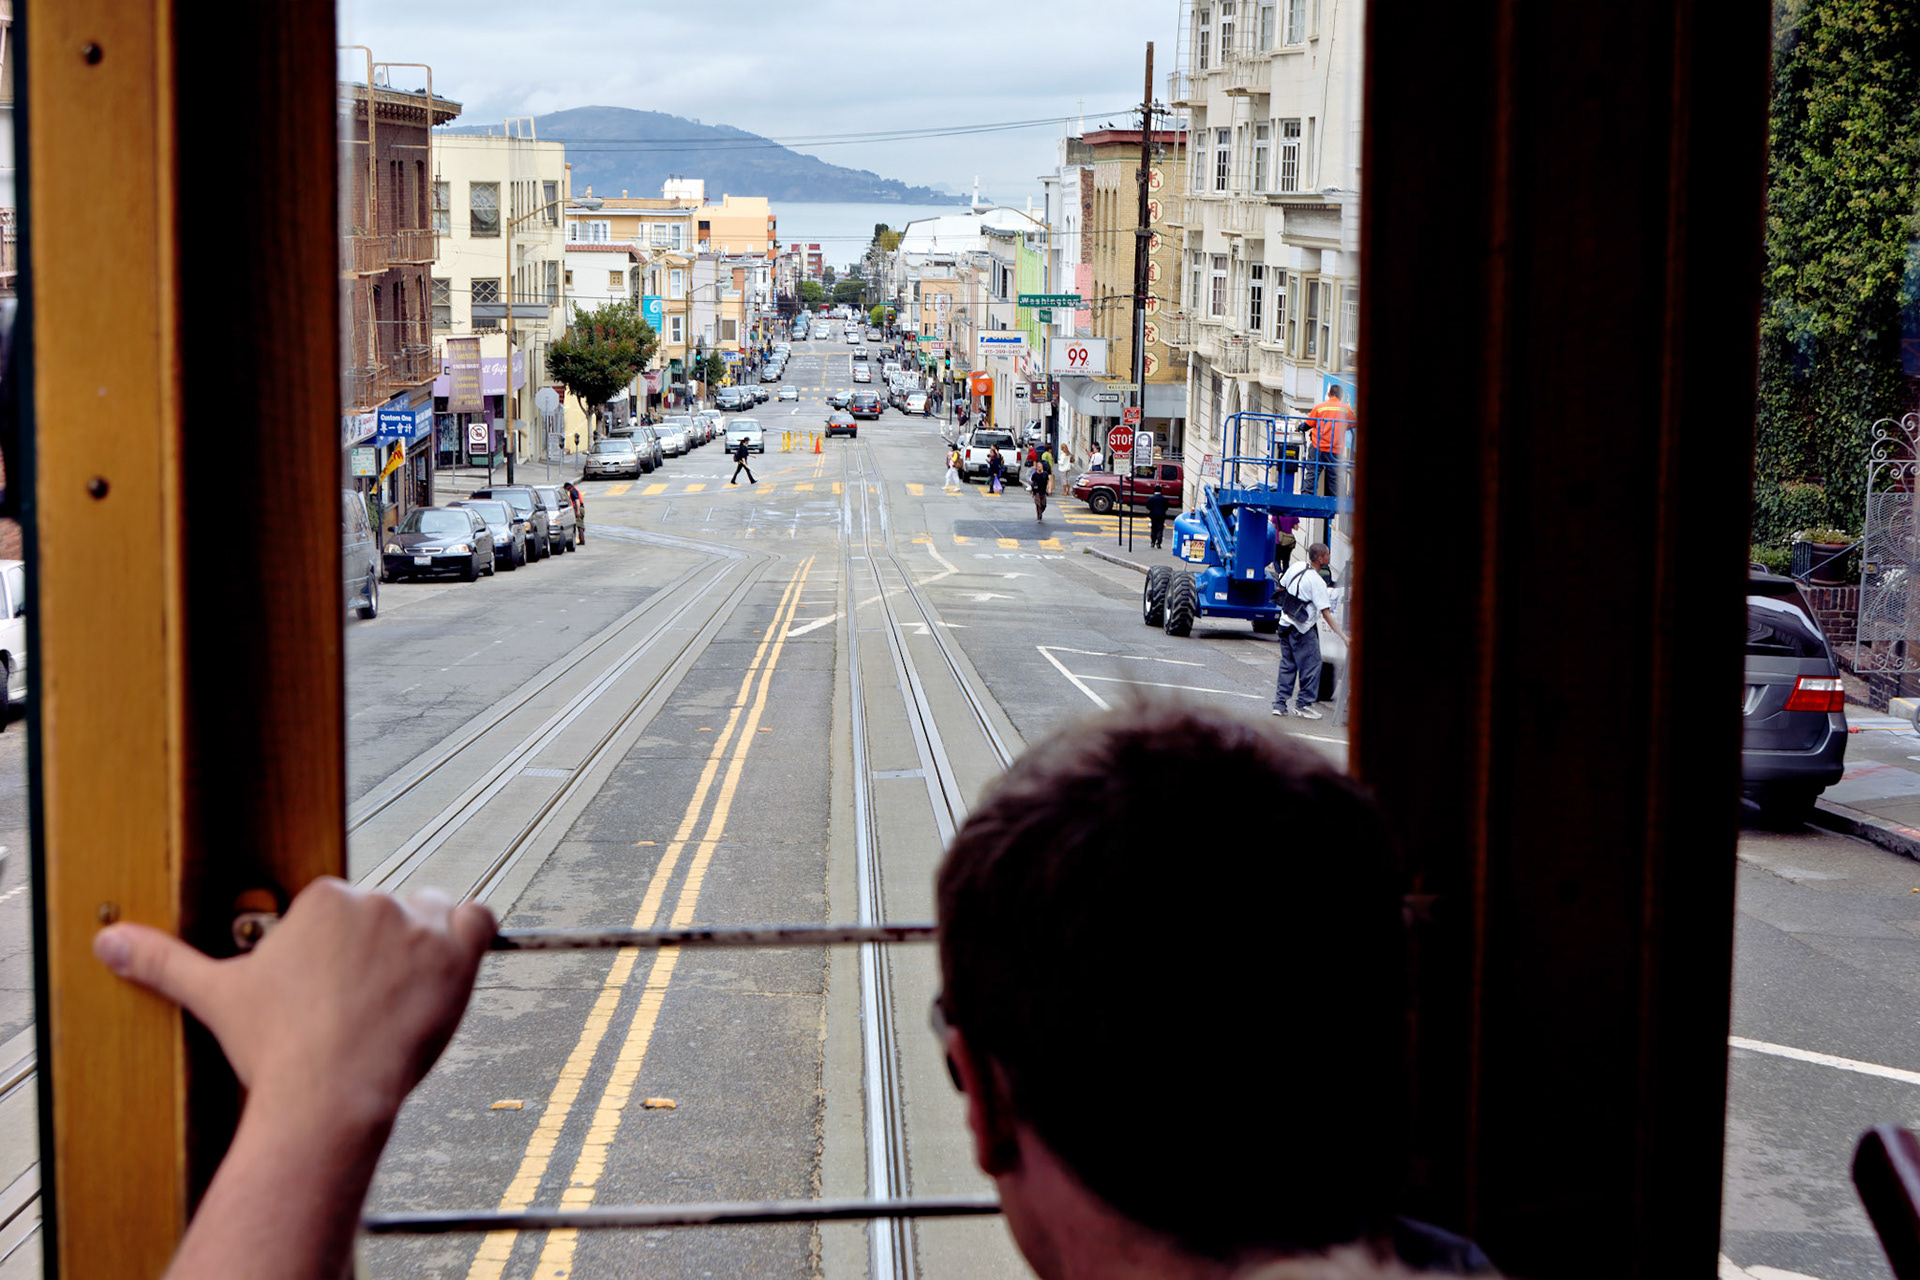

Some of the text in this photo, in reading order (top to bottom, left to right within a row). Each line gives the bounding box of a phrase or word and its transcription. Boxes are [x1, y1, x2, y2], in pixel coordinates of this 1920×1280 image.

[1021, 297, 1079, 306] Washington
[401, 414, 412, 422] One
[1110, 434, 1133, 445] STOP
